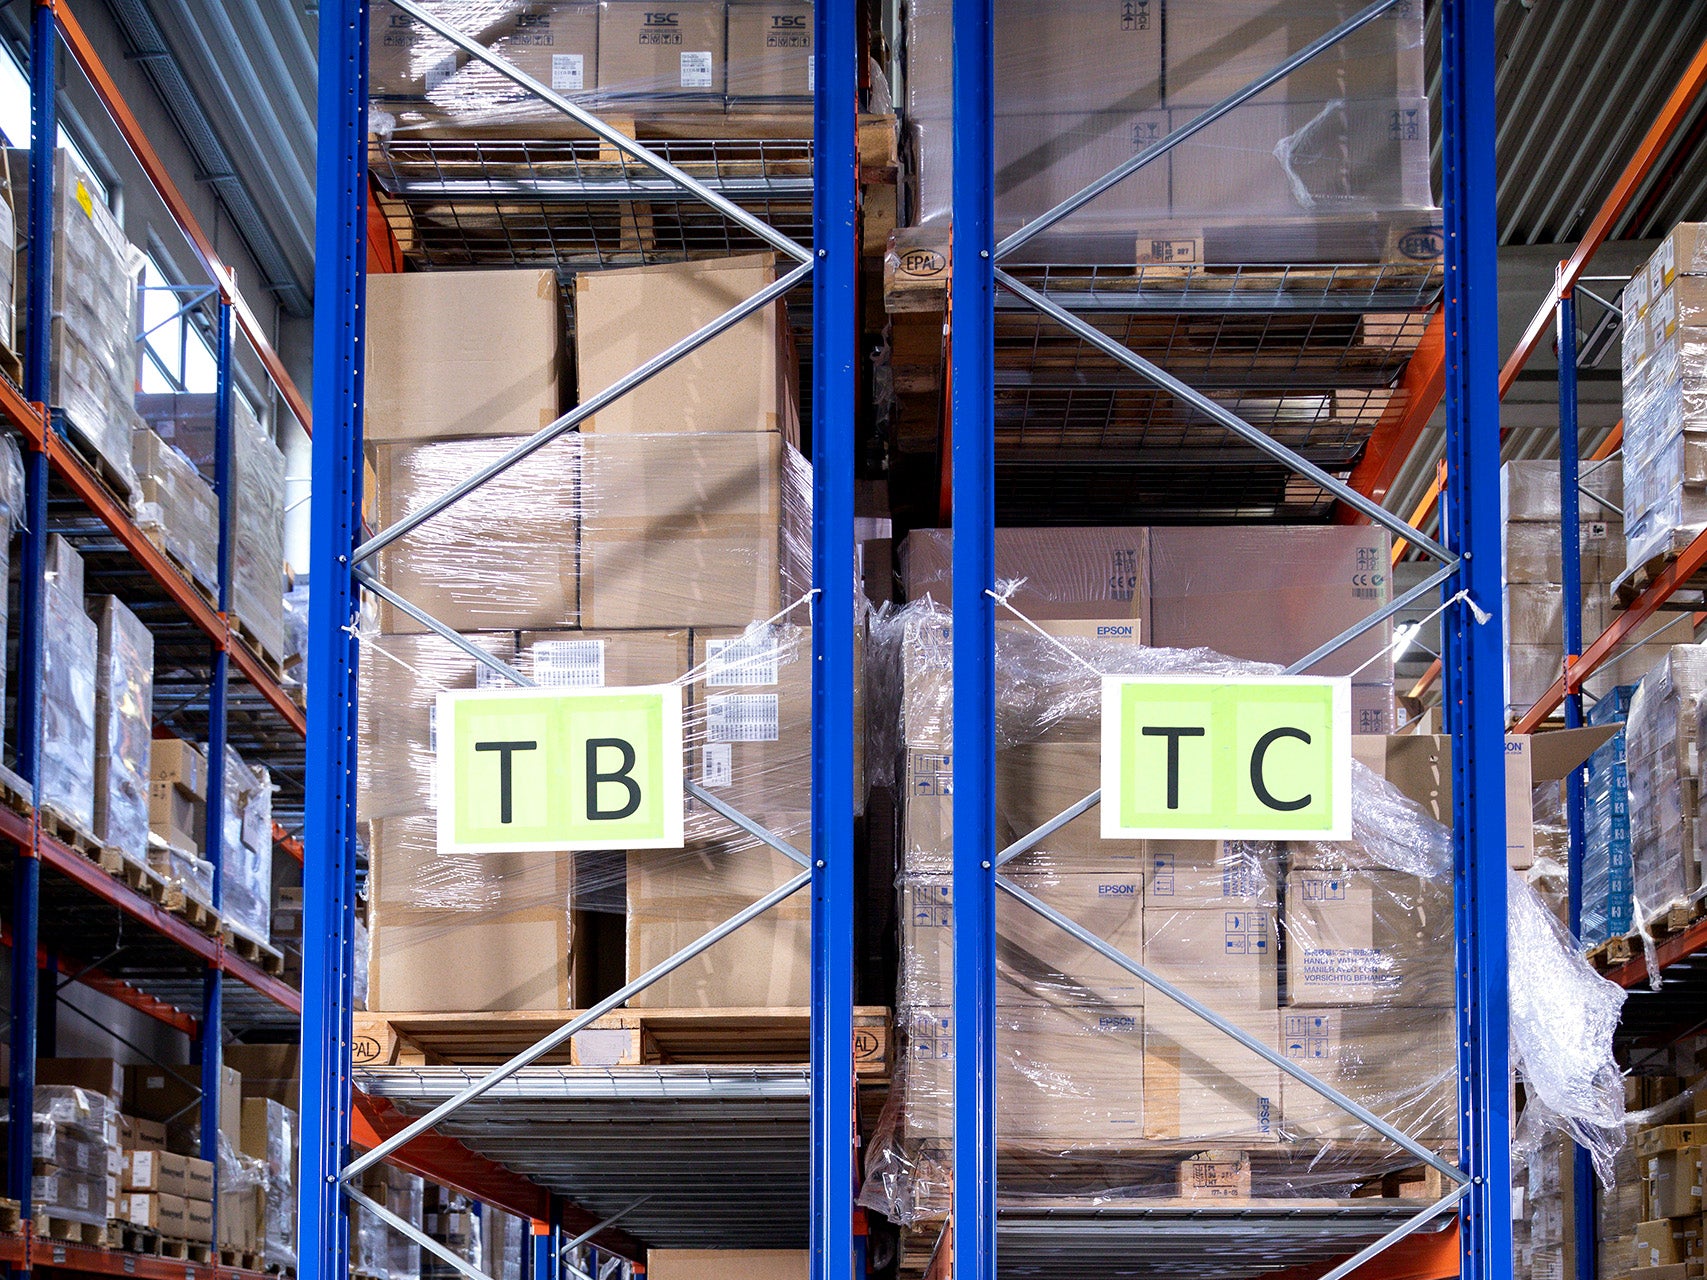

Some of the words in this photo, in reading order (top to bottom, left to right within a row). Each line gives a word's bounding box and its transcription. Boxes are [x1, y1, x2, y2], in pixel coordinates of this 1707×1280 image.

[515, 14, 550, 25] TSC
[644, 13, 679, 23] TSC
[771, 15, 806, 26] TSC
[906, 256, 940, 270] EPAL
[1097, 626, 1132, 635] EPSON
[1142, 727, 1205, 810] T
[1250, 727, 1312, 811] C
[475, 741, 537, 823] T
[586, 738, 642, 821] B
[1098, 885, 1134, 894] EPSON
[1099, 1017, 1135, 1026] EPSON
[1260, 1098, 1270, 1133] EPSON
